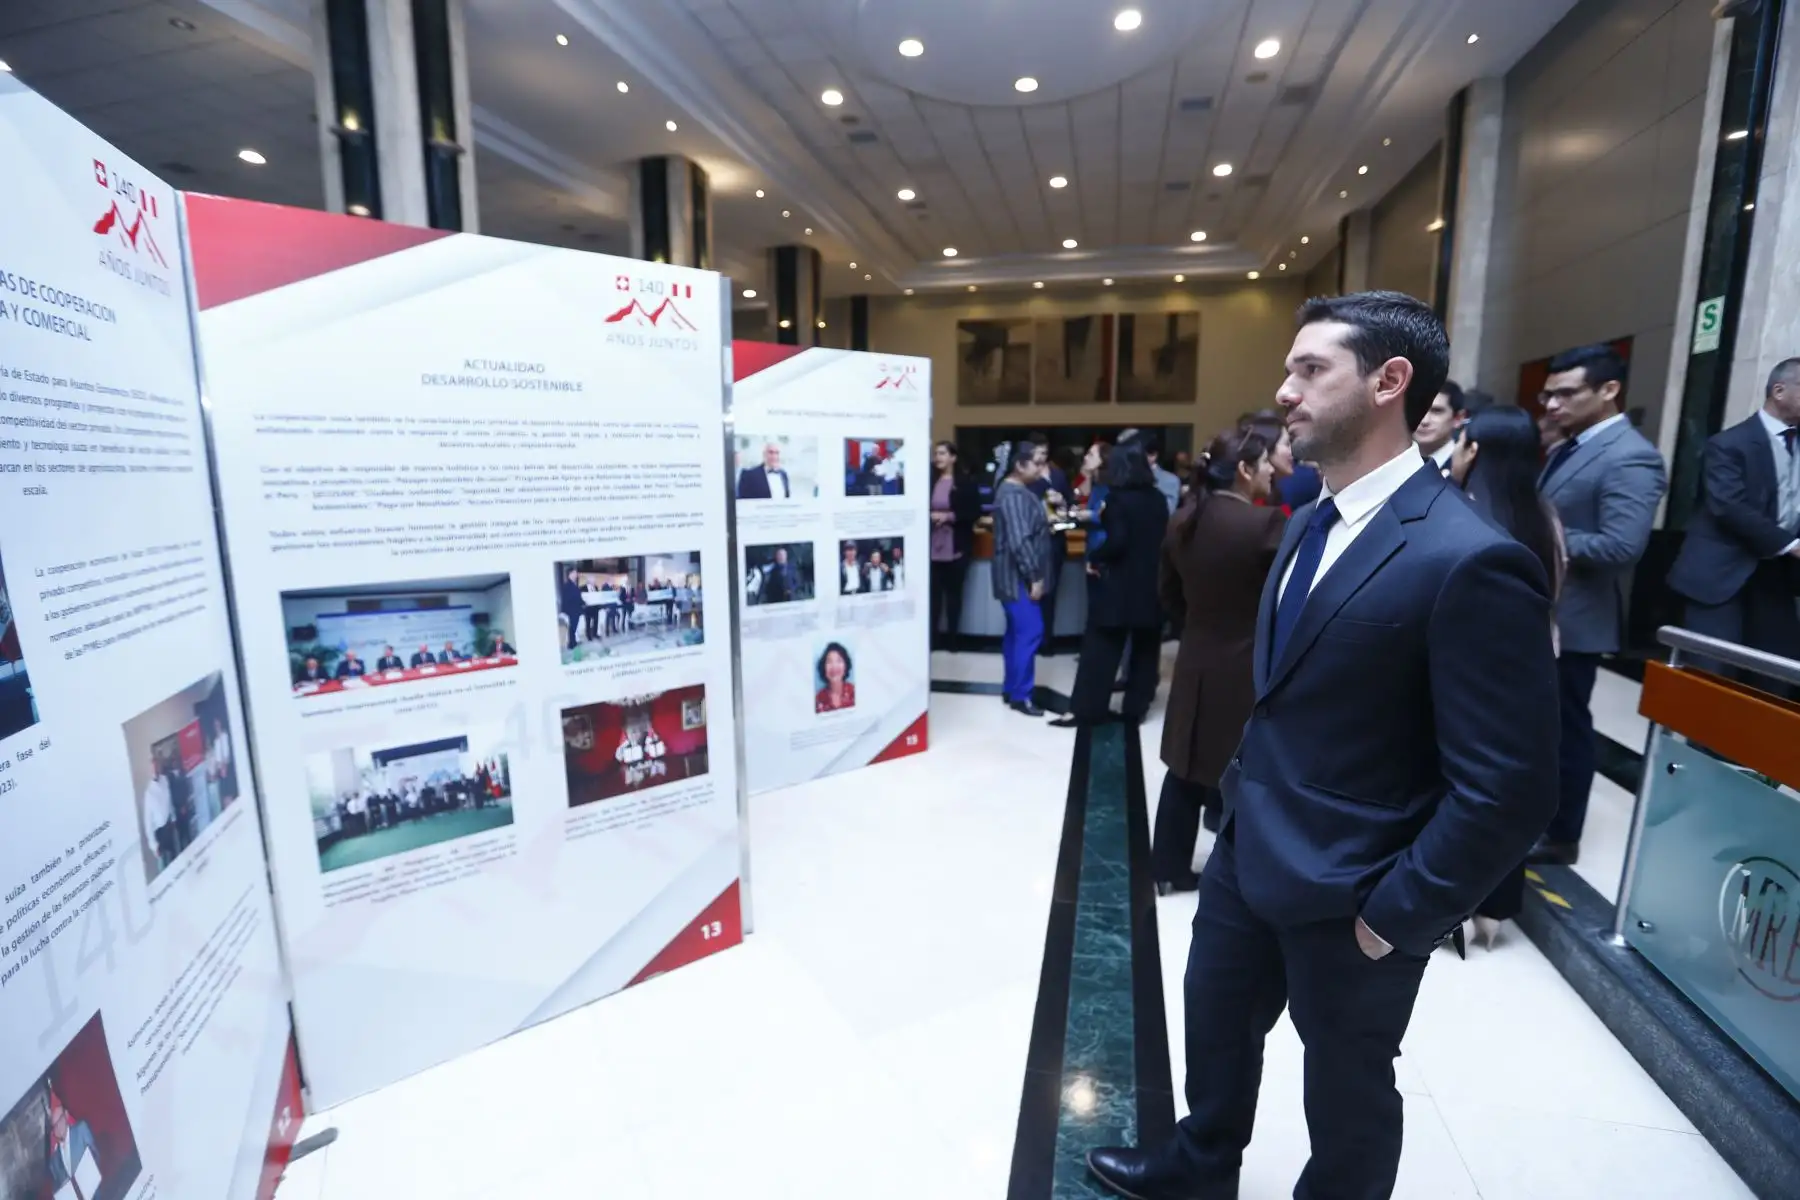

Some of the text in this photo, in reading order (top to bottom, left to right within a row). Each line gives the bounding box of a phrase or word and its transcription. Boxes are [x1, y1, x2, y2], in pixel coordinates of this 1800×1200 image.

[19, 275, 38, 299] DE
[638, 278, 664, 296] 140
[10, 302, 18, 322] Y
[23, 307, 92, 342] COMERCIAL
[1702, 303, 1718, 331] S
[648, 336, 699, 351] JUNTOS
[463, 358, 546, 374] ACTUALIDAD
[11, 368, 22, 381] de
[24, 370, 50, 385] Estado
[421, 373, 584, 393] DESARROLLO SOSTENIBLE
[9, 390, 42, 406] diversos
[35, 460, 46, 473] los
[16, 747, 34, 762] fase
[0, 777, 18, 796] 23).
[4, 882, 26, 905] suiza
[30, 855, 62, 884] también
[6, 897, 41, 931] políticas
[41, 863, 83, 900] económicas
[1, 942, 10, 958] la
[11, 919, 41, 953] gestión
[41, 907, 52, 924] de
[52, 900, 63, 915] las
[701, 920, 722, 940] 13
[0, 961, 20, 988] para
[20, 952, 29, 967] la
[29, 934, 50, 960] lucha
[50, 912, 73, 940] contra
